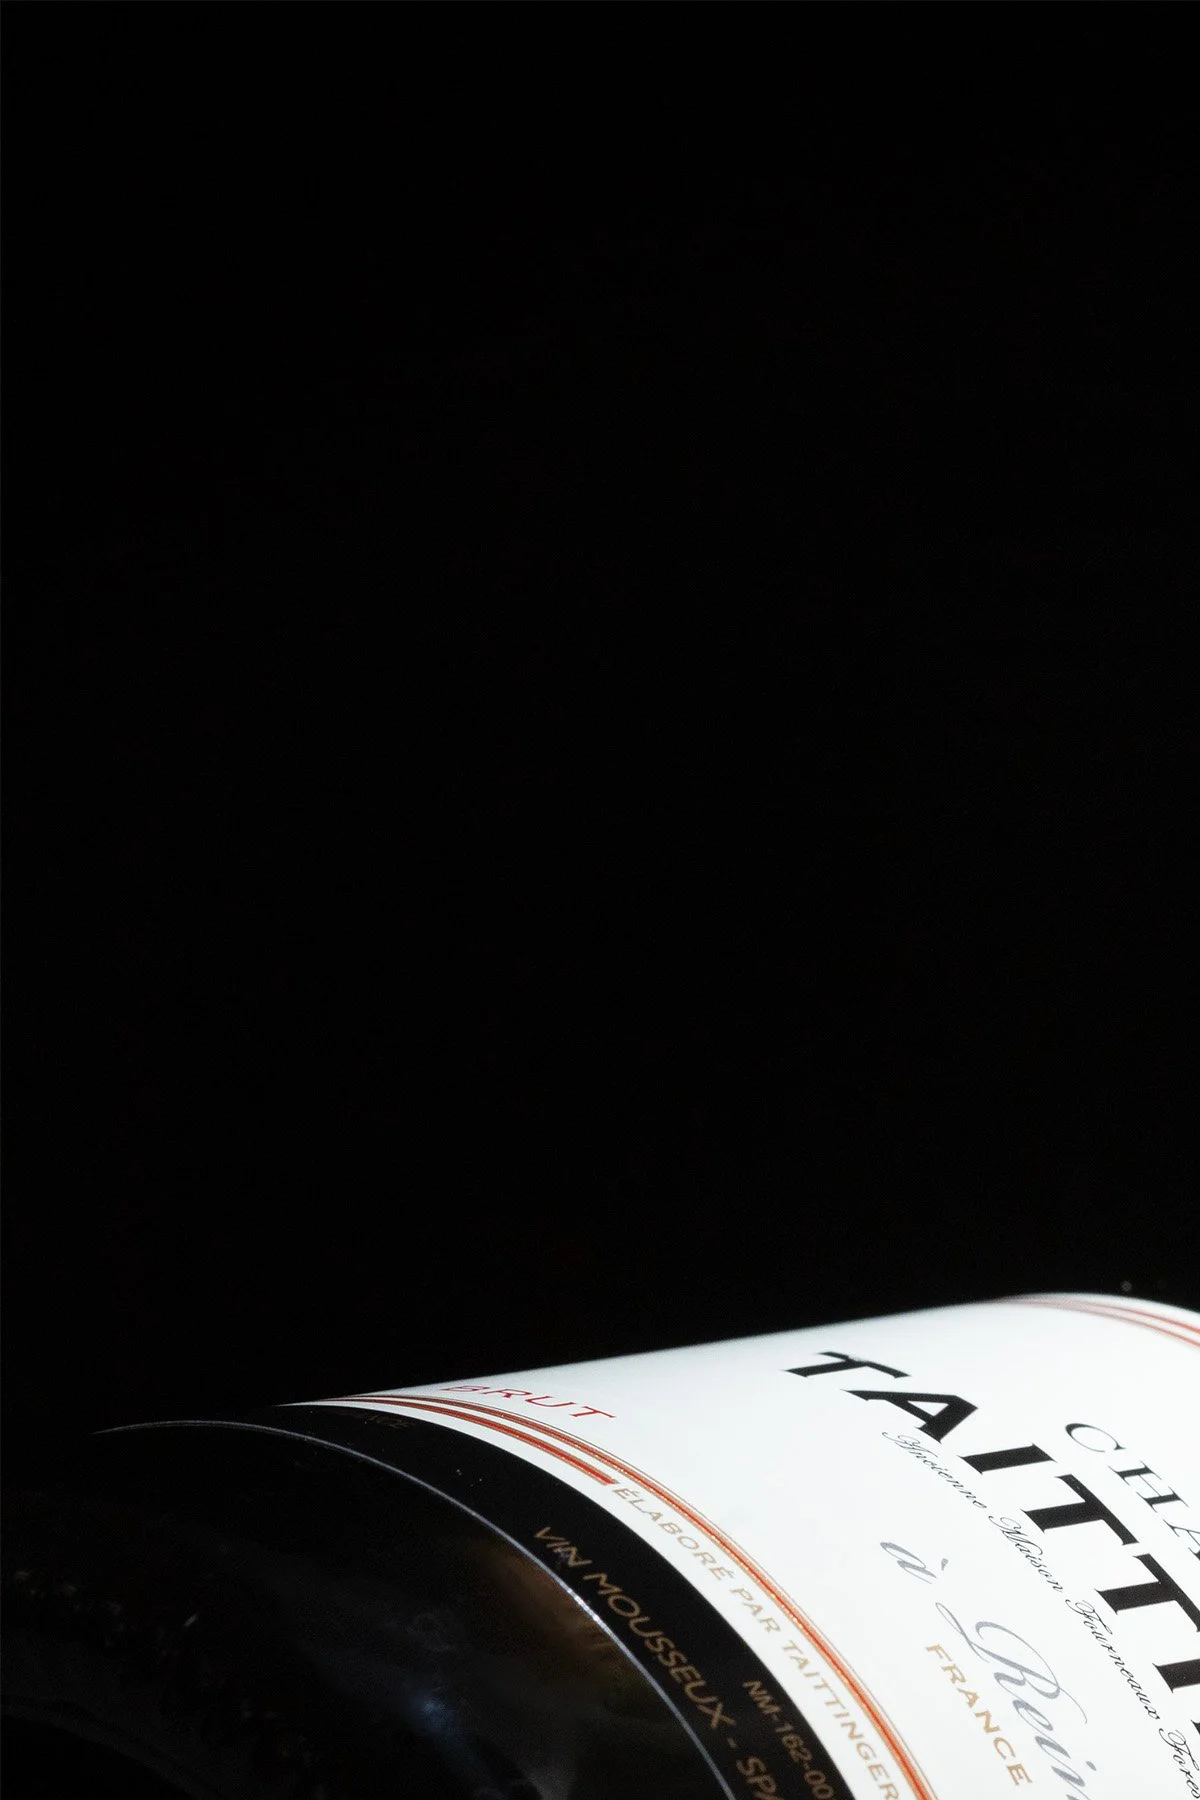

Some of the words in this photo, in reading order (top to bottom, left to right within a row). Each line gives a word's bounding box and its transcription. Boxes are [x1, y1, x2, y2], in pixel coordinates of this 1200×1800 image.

[442, 1384, 616, 1420] BRUT
[533, 1526, 593, 1569] VIN
[582, 1572, 737, 1730] MOUSSEUX
[612, 1486, 735, 1582] ÉLABORÉ
[728, 1586, 781, 1634] PAR
[880, 1540, 949, 1585] à
[881, 1431, 987, 1509] Ancienne
[988, 1515, 1063, 1592] Maison
[1065, 1599, 1161, 1721] Fourneaux
[924, 1643, 1033, 1787] FRANCE
